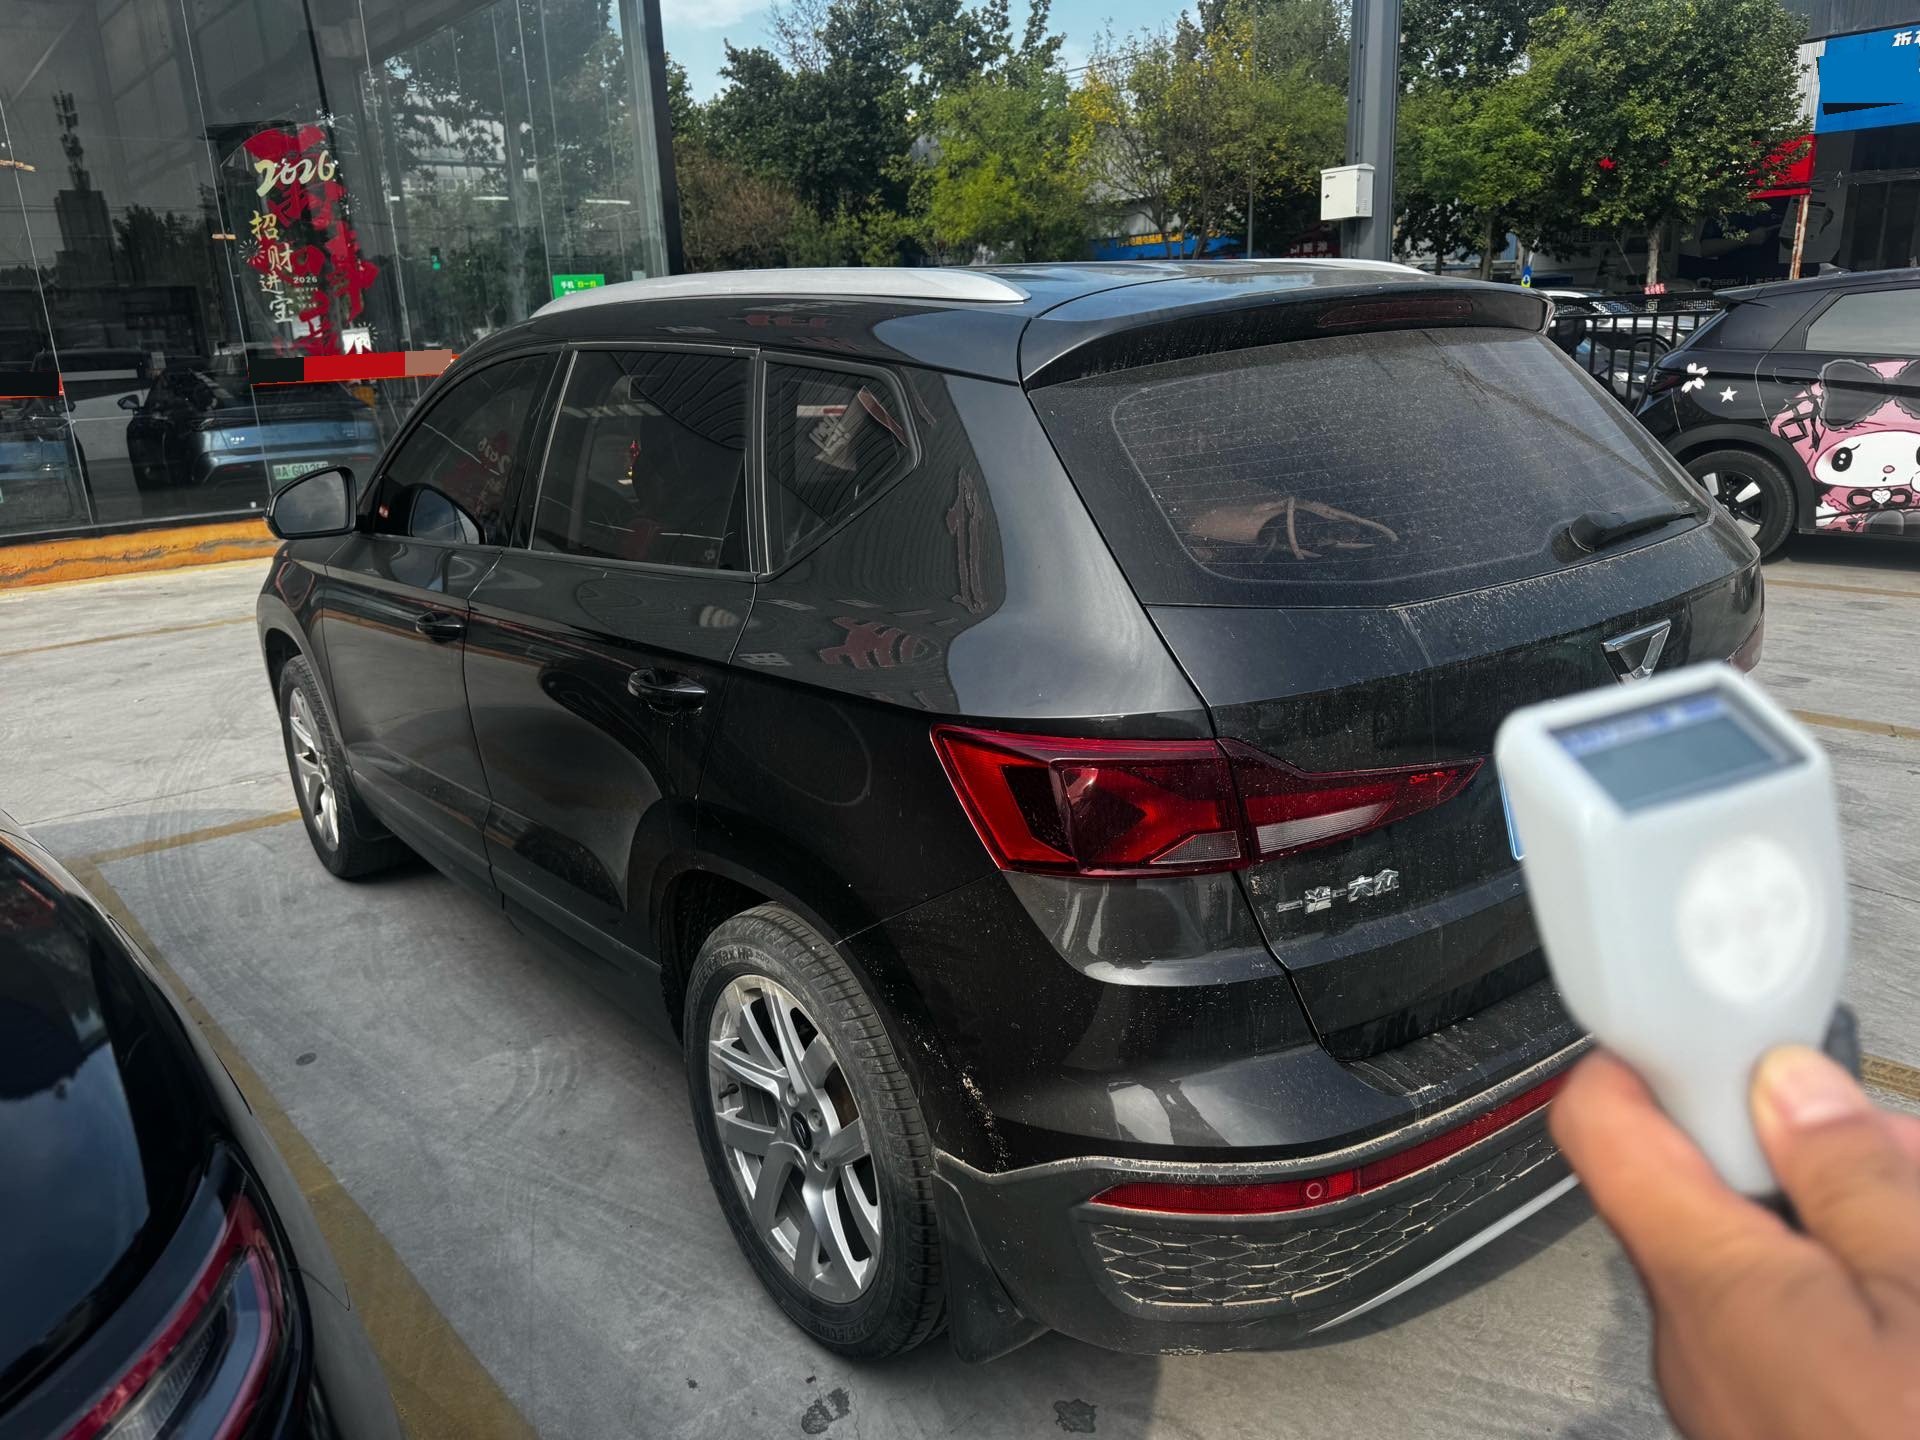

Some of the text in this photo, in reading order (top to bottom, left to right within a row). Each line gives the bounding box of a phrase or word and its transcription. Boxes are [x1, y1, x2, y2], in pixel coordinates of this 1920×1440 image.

[254, 150, 335, 198] 2026
[249, 210, 295, 324] 招财进宝
[293, 275, 318, 284] 2026
[1276, 868, 1400, 914] 一汽-大众
